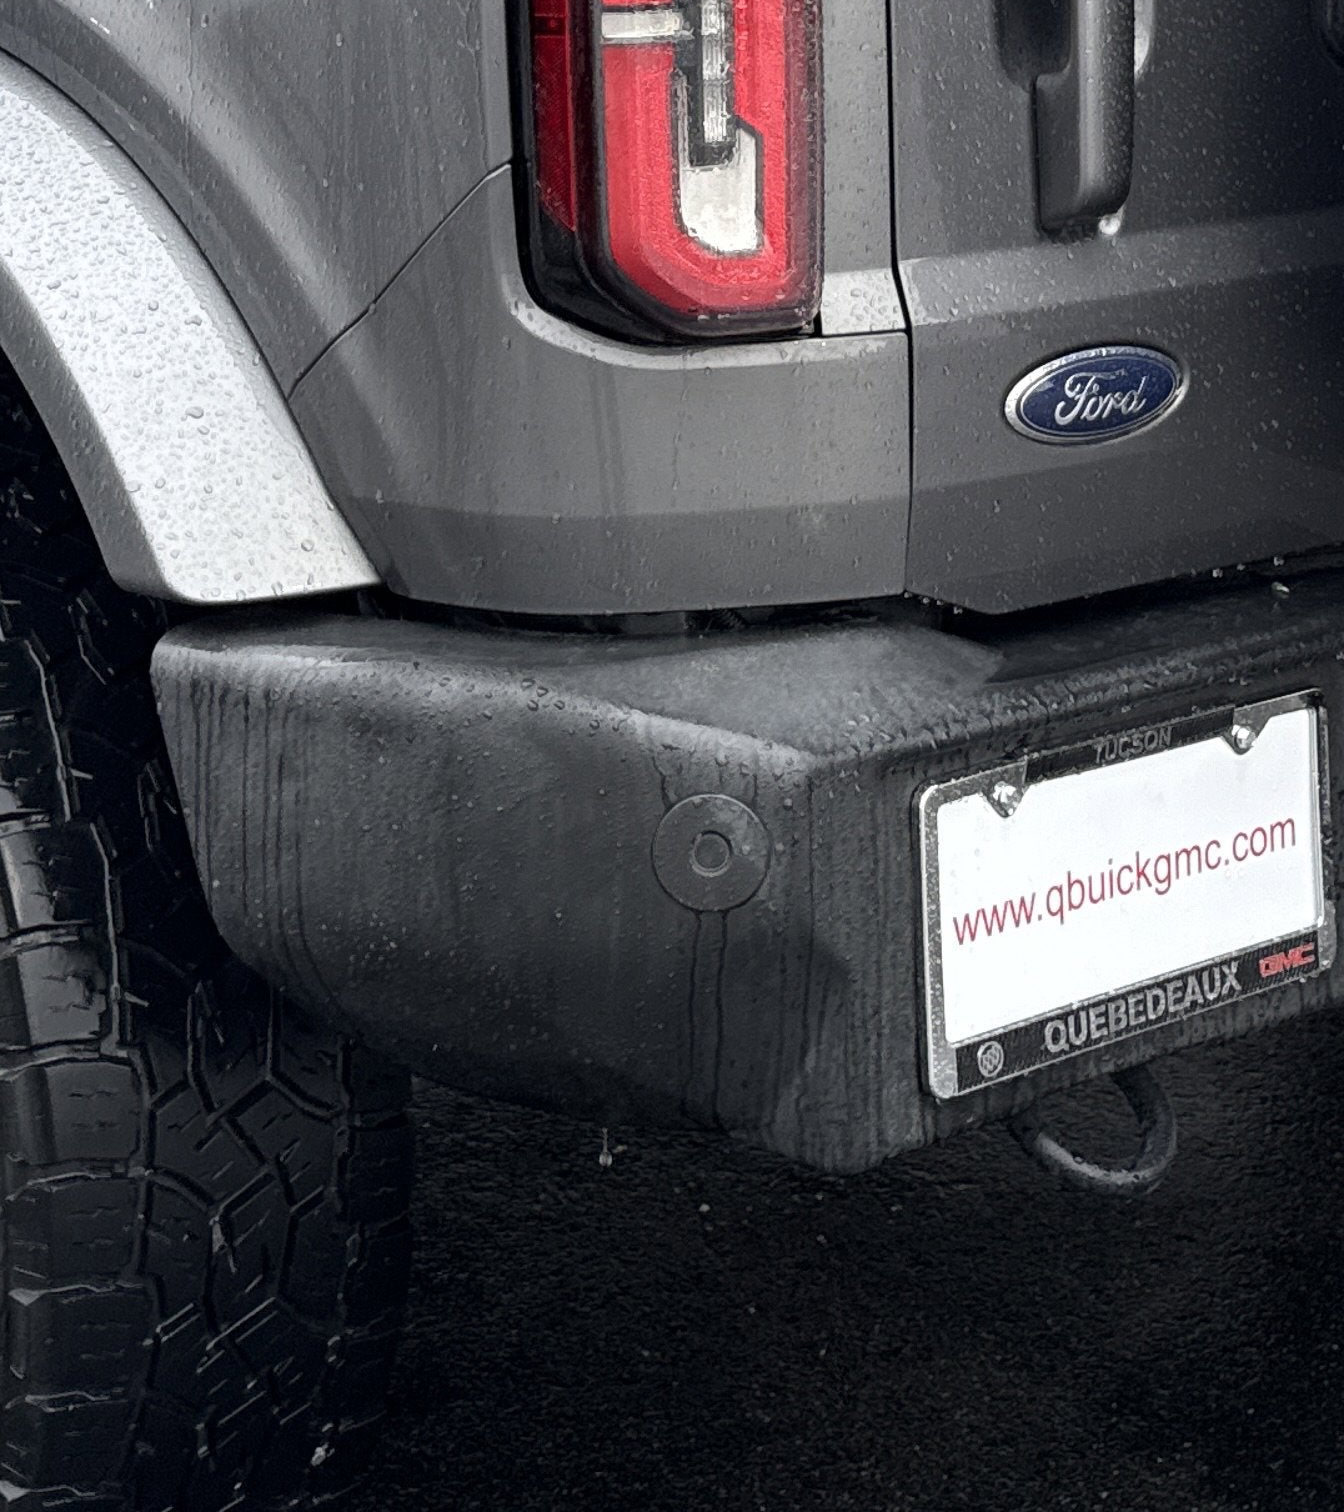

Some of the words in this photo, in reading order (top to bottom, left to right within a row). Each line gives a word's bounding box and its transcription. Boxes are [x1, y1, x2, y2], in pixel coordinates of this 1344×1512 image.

[1054, 368, 1148, 426] Ford
[1094, 726, 1174, 764] TUCSON
[952, 817, 1296, 946] www.qbuickgmc.com
[1043, 961, 1243, 1053] QUEBEDEAUX
[1258, 942, 1316, 978] GMC
